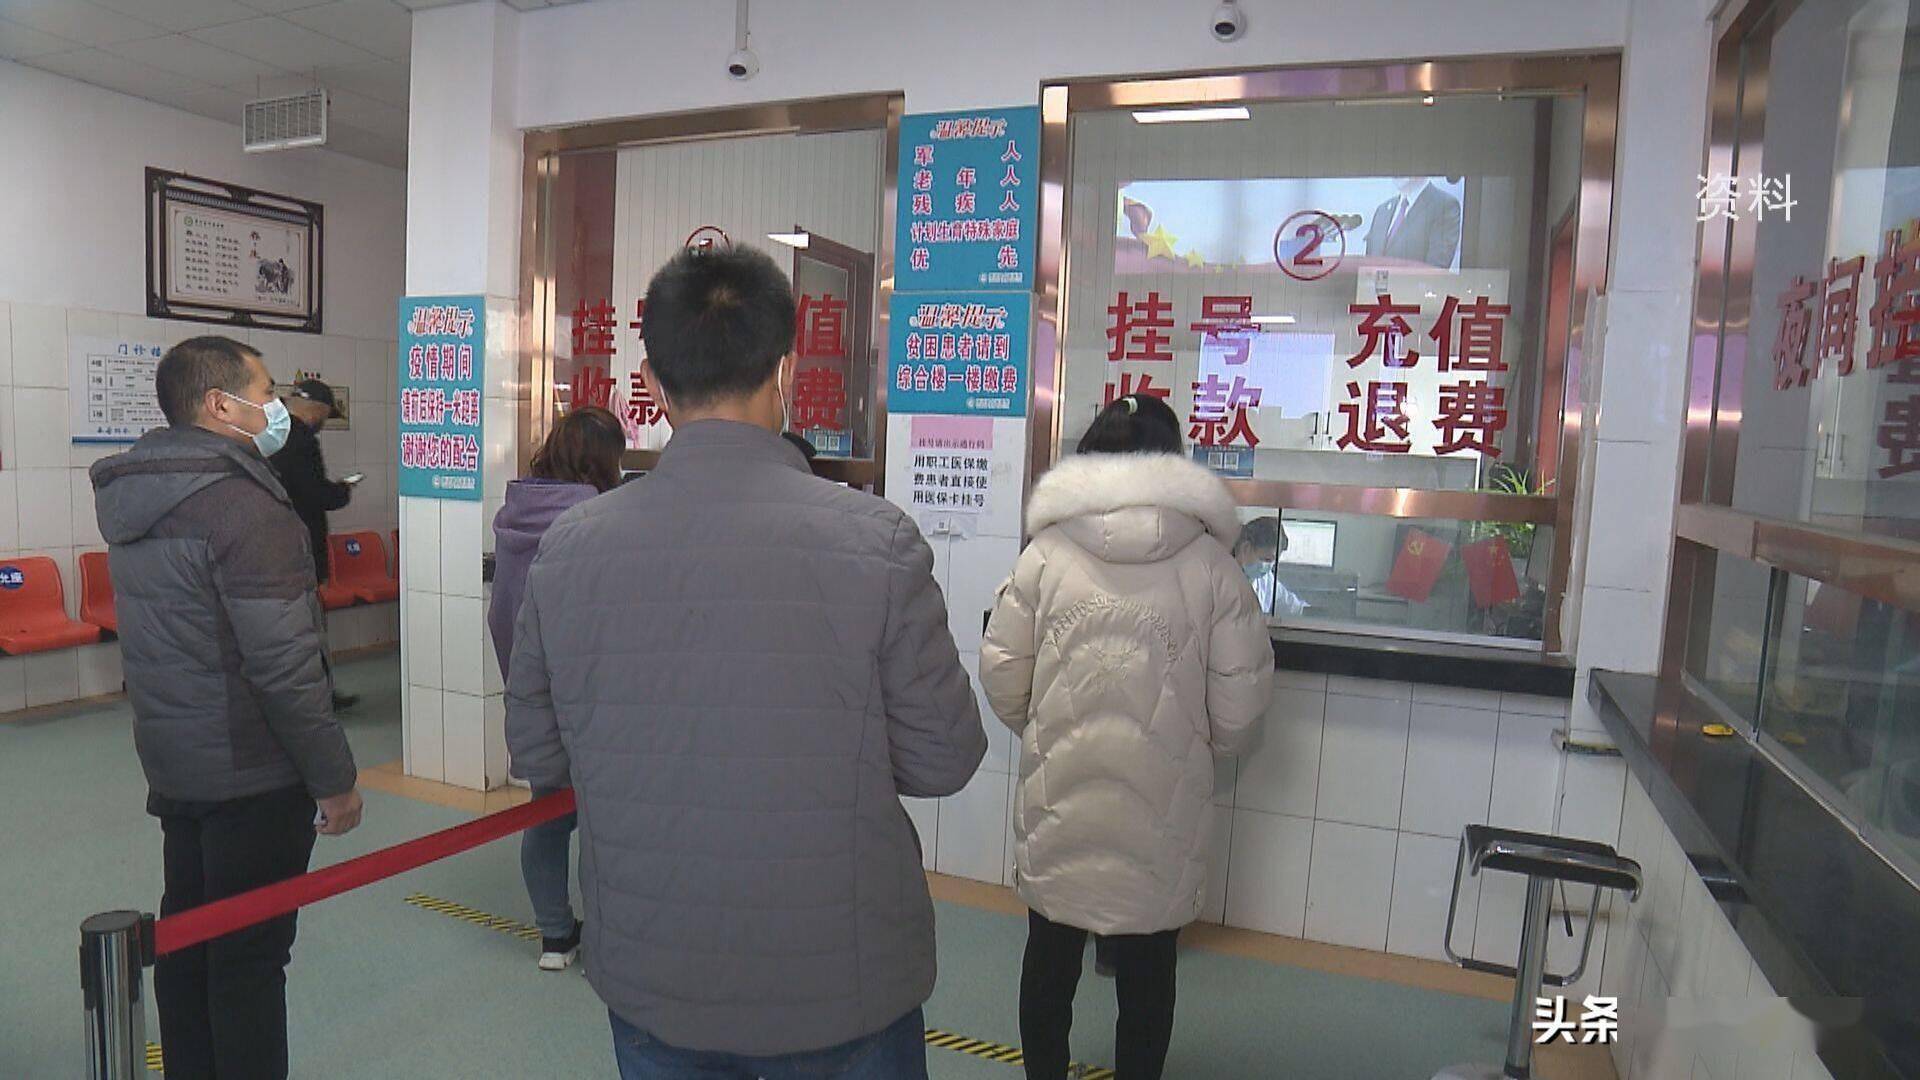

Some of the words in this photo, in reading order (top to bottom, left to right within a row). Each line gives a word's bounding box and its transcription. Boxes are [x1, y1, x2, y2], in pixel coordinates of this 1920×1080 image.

[931, 118, 1007, 139] 温馨提示
[913, 165, 1021, 190] 老年人
[912, 190, 1020, 215] 残疾人
[911, 218, 1019, 243] 计划生育特殊家庭
[408, 306, 474, 338] 温馨提示
[909, 304, 1007, 329] 温馨提示
[906, 332, 1010, 360] 贫困患者请到
[409, 344, 473, 380] 疫情期间
[896, 364, 1017, 392] 综合楼一楼缴费
[401, 388, 480, 425] 请前后保持一米距离
[1336, 380, 1508, 458] 退费
[401, 433, 480, 471] 谢谢您的配合
[914, 454, 988, 471] 用职工医保缴
[914, 472, 988, 489] 费患者直接使
[913, 490, 985, 507] 用医保卡挂号
